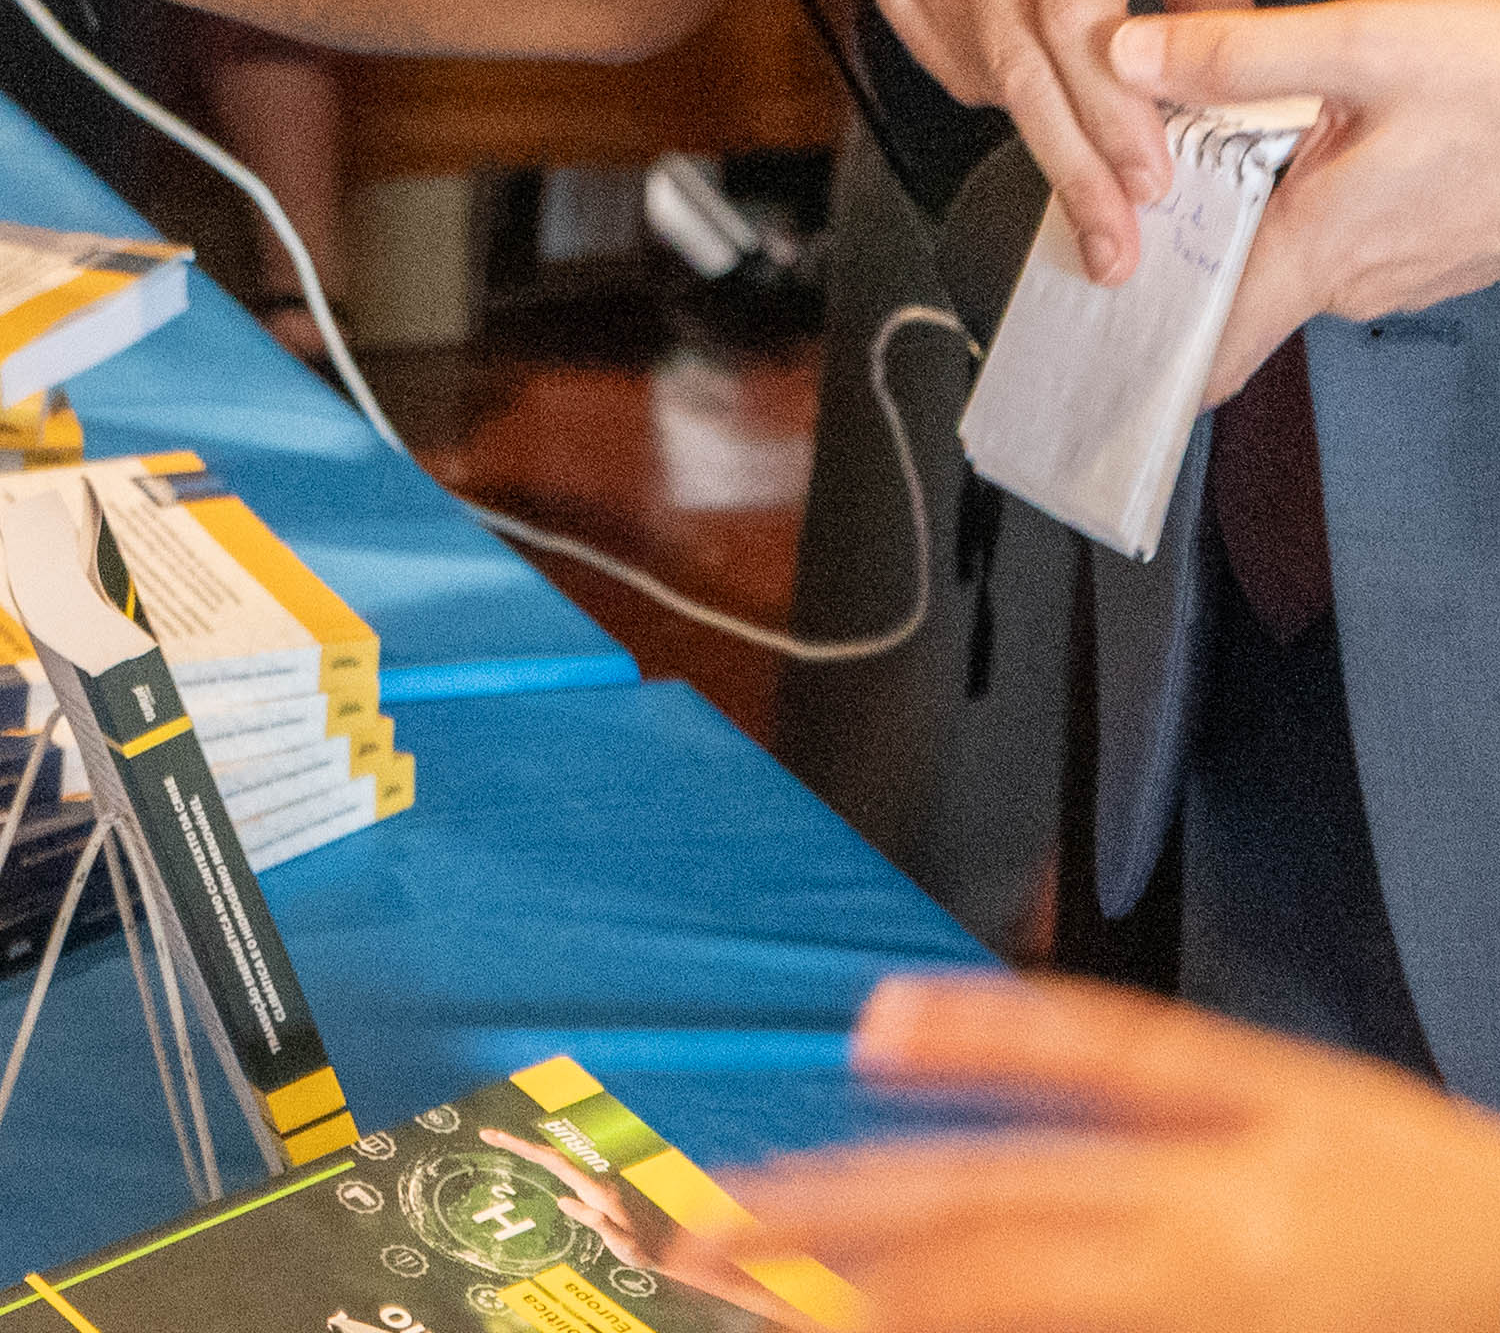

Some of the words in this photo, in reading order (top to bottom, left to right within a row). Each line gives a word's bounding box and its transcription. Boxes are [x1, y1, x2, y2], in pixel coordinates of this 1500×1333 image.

[164, 773, 183, 813] CRISE
[186, 828, 218, 898] CONTEXTO
[220, 911, 254, 987] ENERGÉTICA
[249, 984, 281, 1054] TRANSIÇÃO
[256, 957, 286, 1023] CLIMÁTICA
[522, 1293, 581, 1333] olítica
[564, 1282, 632, 1333] Europa
